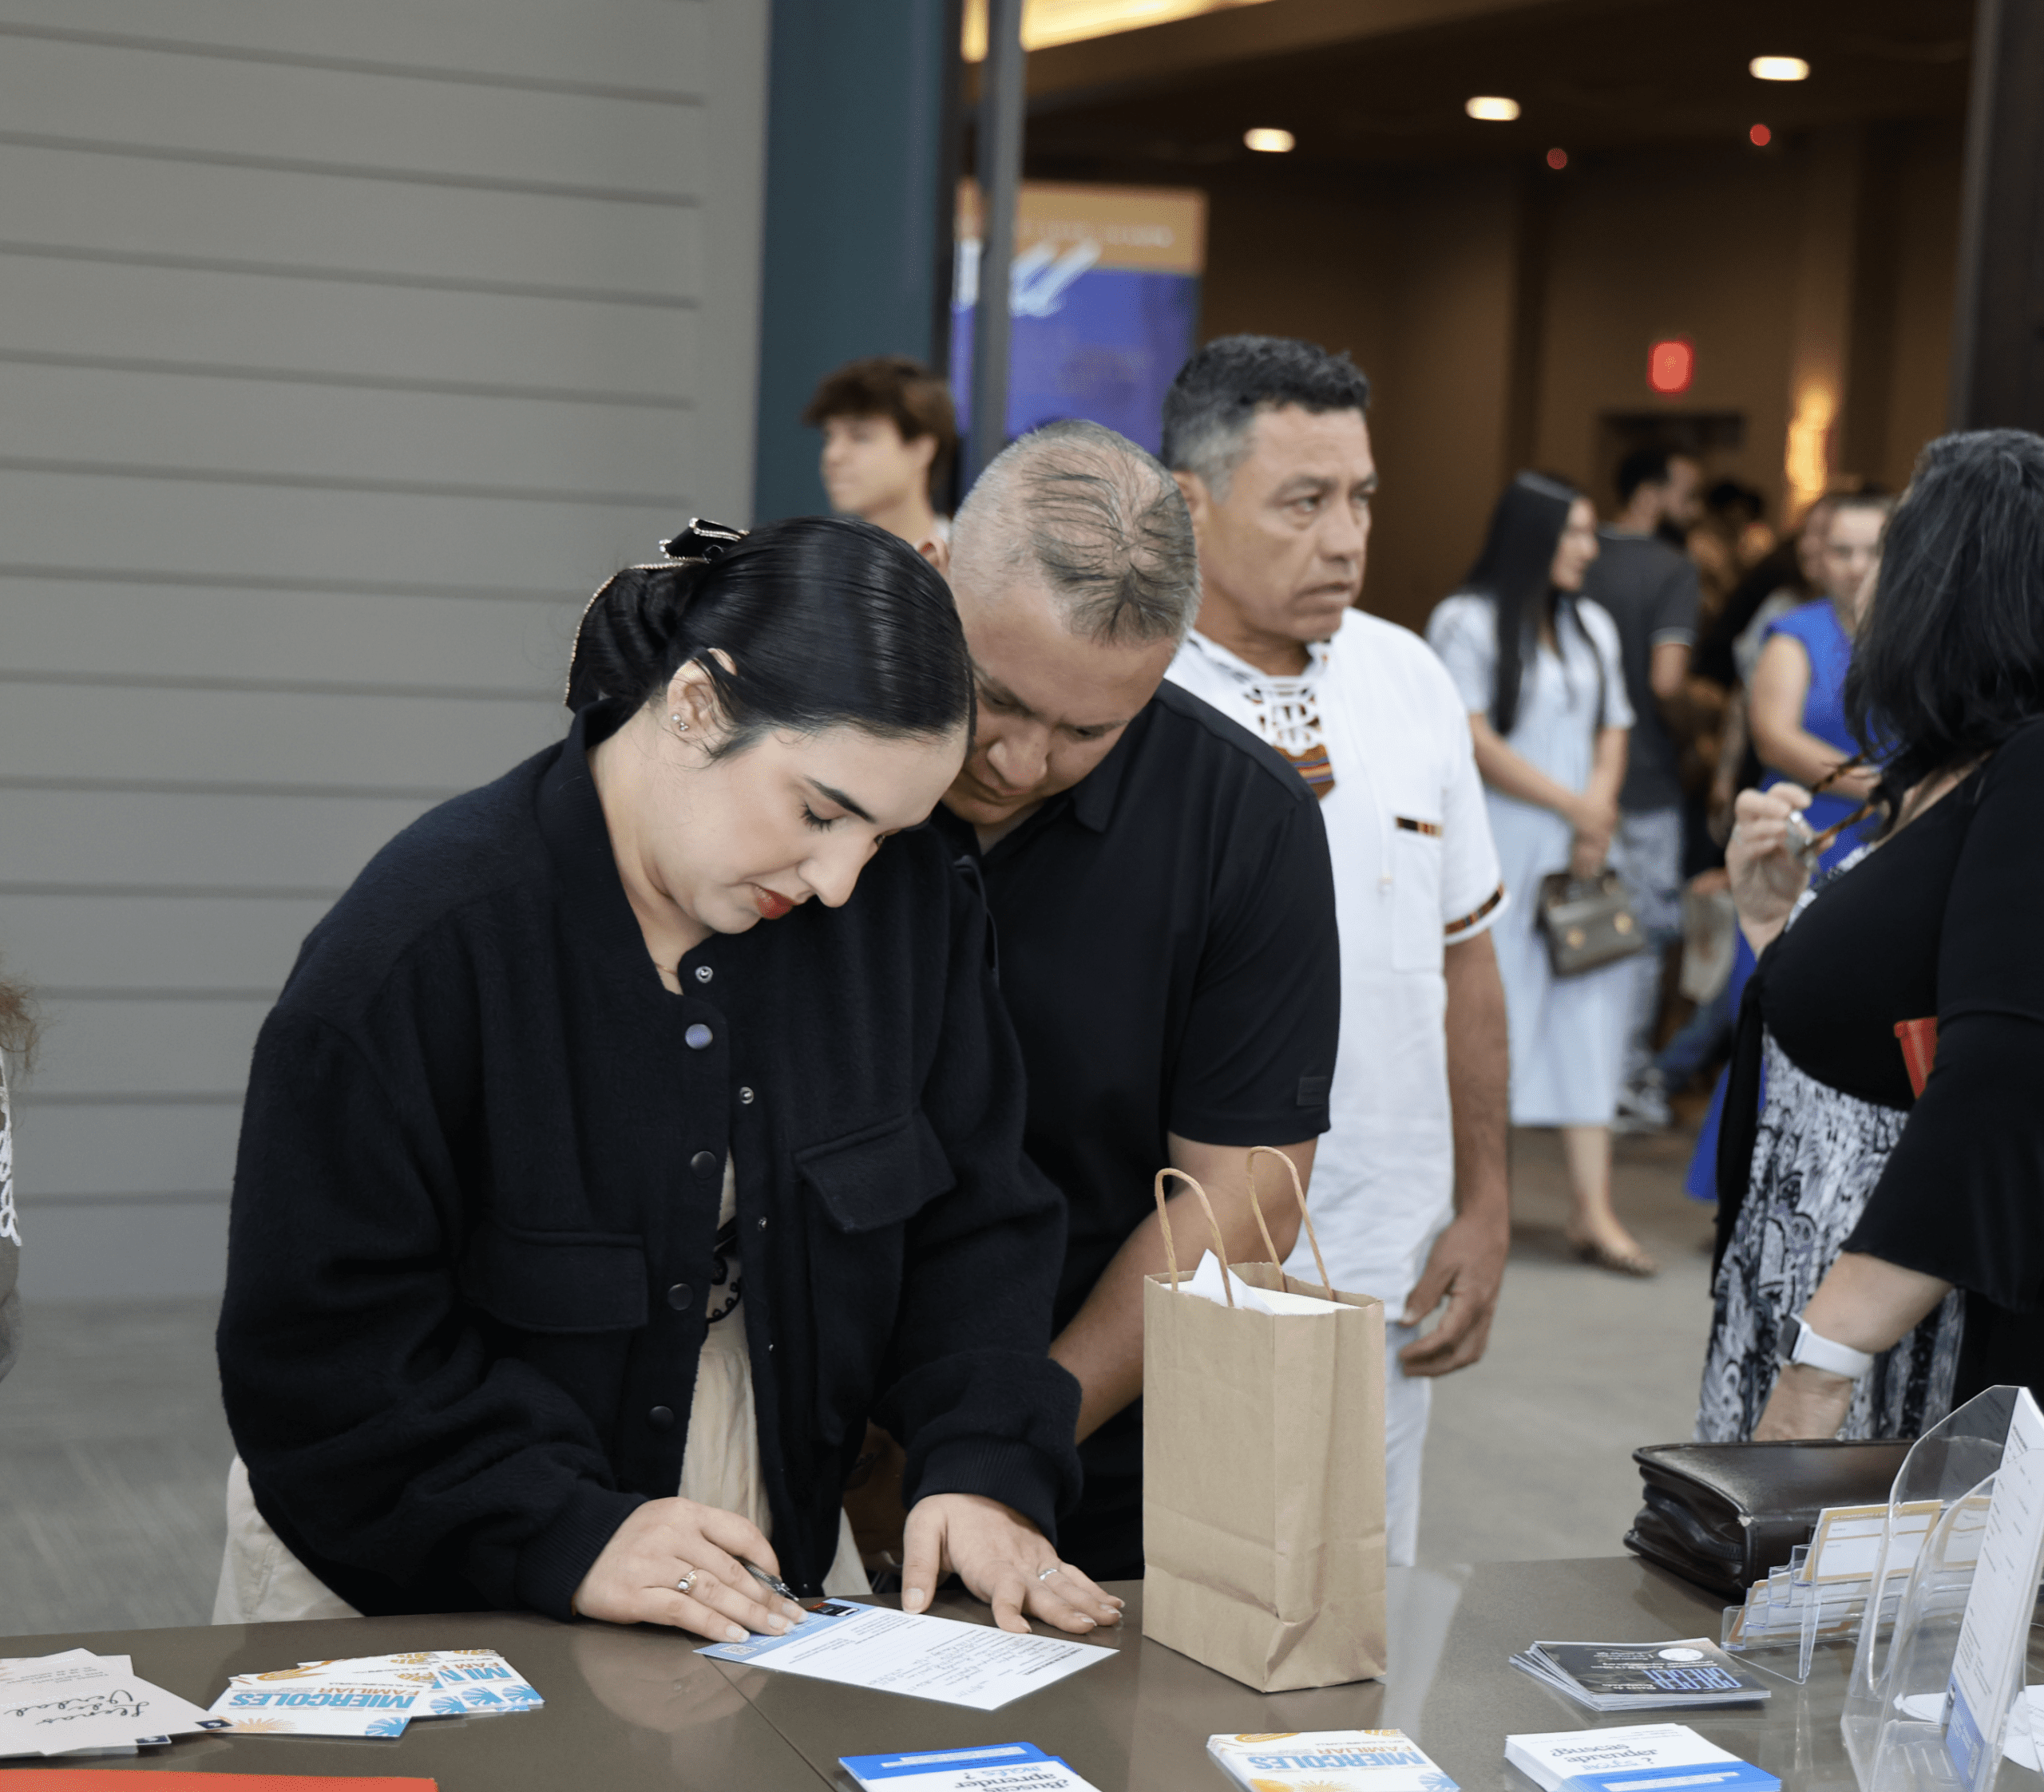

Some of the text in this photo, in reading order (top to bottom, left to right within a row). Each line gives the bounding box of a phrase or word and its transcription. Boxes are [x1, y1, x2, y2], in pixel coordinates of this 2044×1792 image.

[1642, 1667, 1742, 1690] CRECER
[318, 1687, 420, 1696] FAMILIAR
[228, 1692, 416, 1709] MIERCOLES
[1316, 1746, 1412, 1755] FAMILIAR
[1563, 1748, 1658, 1763] aprender
[1246, 1751, 1427, 1770] MIERCOLES
[955, 1773, 1056, 1789] aprender
